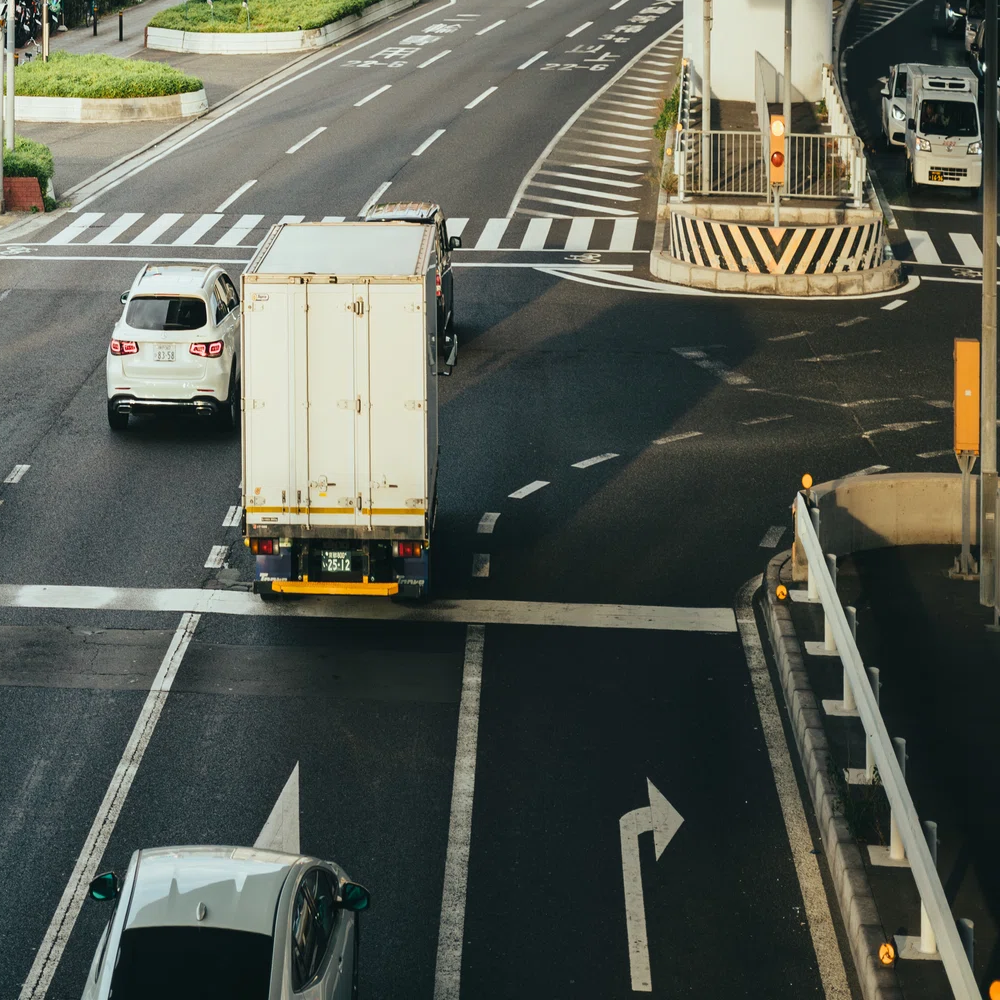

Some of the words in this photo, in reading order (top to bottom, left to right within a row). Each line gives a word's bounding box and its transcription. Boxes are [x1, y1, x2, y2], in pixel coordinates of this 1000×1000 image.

[540, 63, 610, 72] 22-6
[157, 351, 175, 360] 83-58
[327, 558, 351, 572] 25-12
